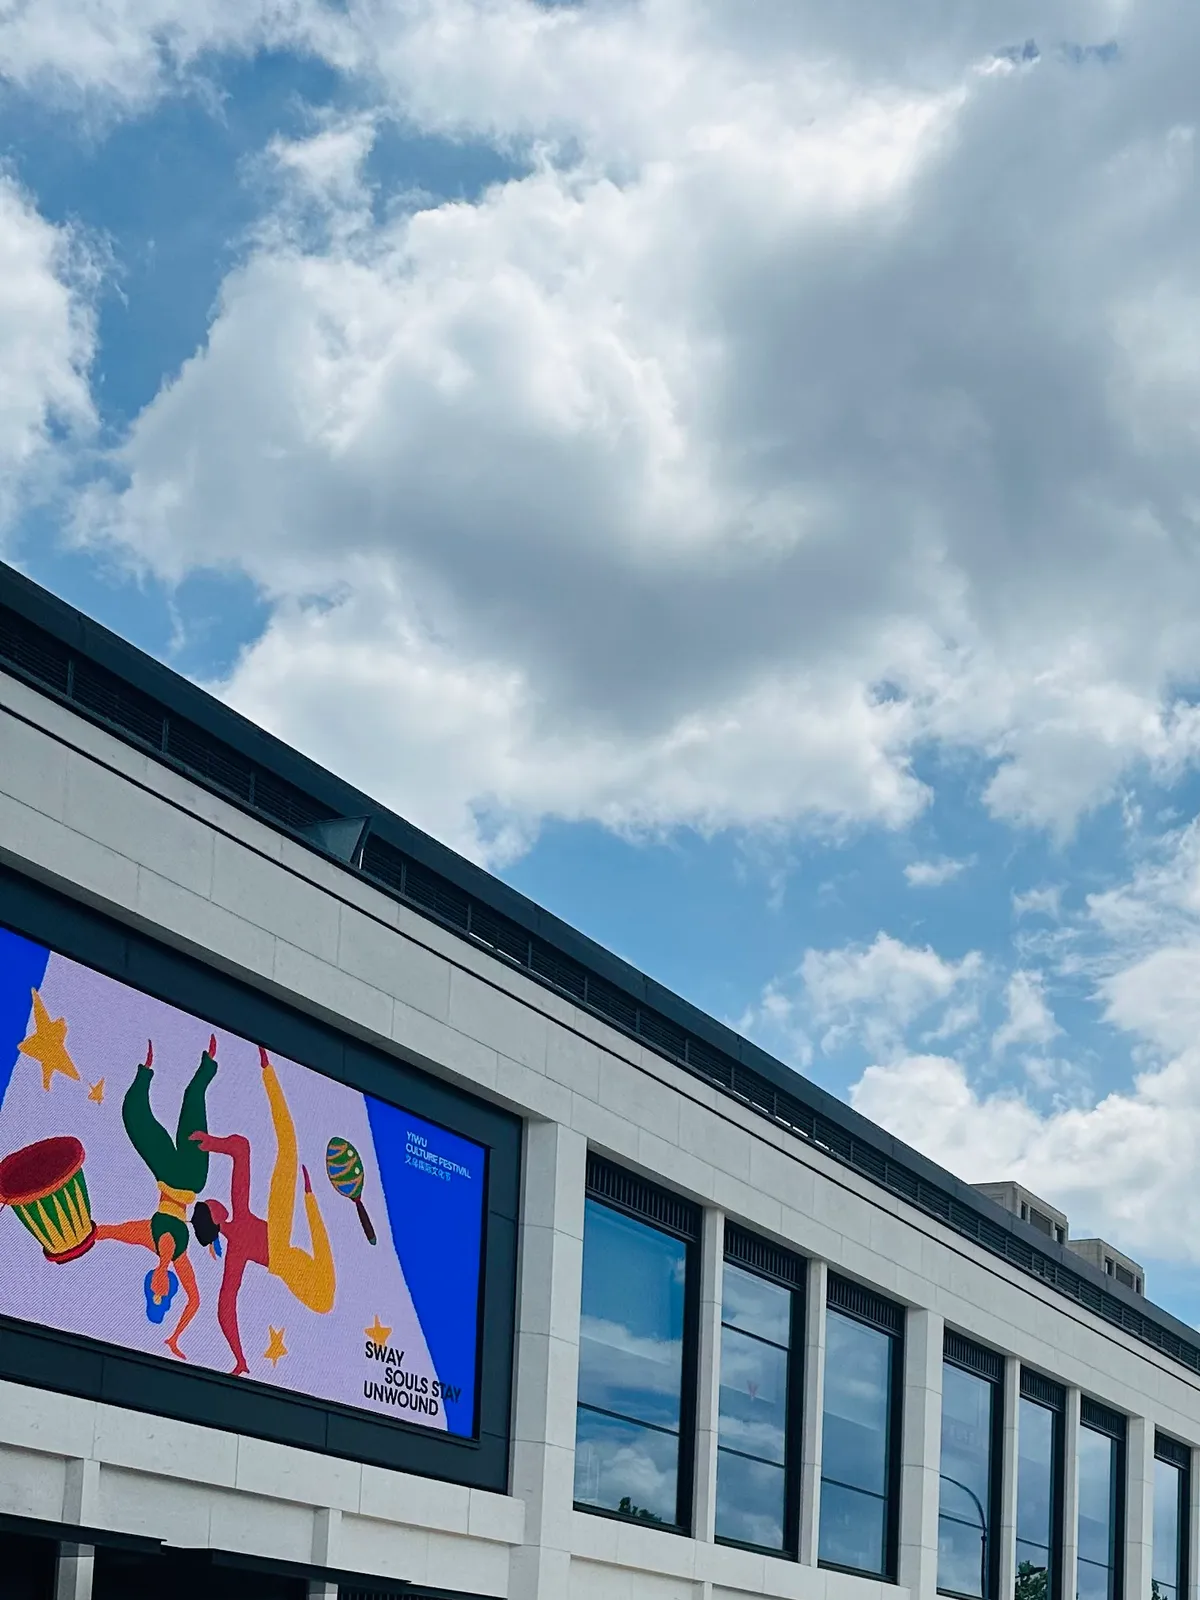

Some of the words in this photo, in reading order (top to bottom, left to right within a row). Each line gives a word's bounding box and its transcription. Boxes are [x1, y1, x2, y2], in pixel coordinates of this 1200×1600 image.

[438, 1156, 472, 1179] FESTIVAL
[365, 1341, 404, 1367] SWAY
[363, 1380, 439, 1416] UNWOUND
[384, 1366, 428, 1395] SOULS
[431, 1380, 462, 1404] STAY
